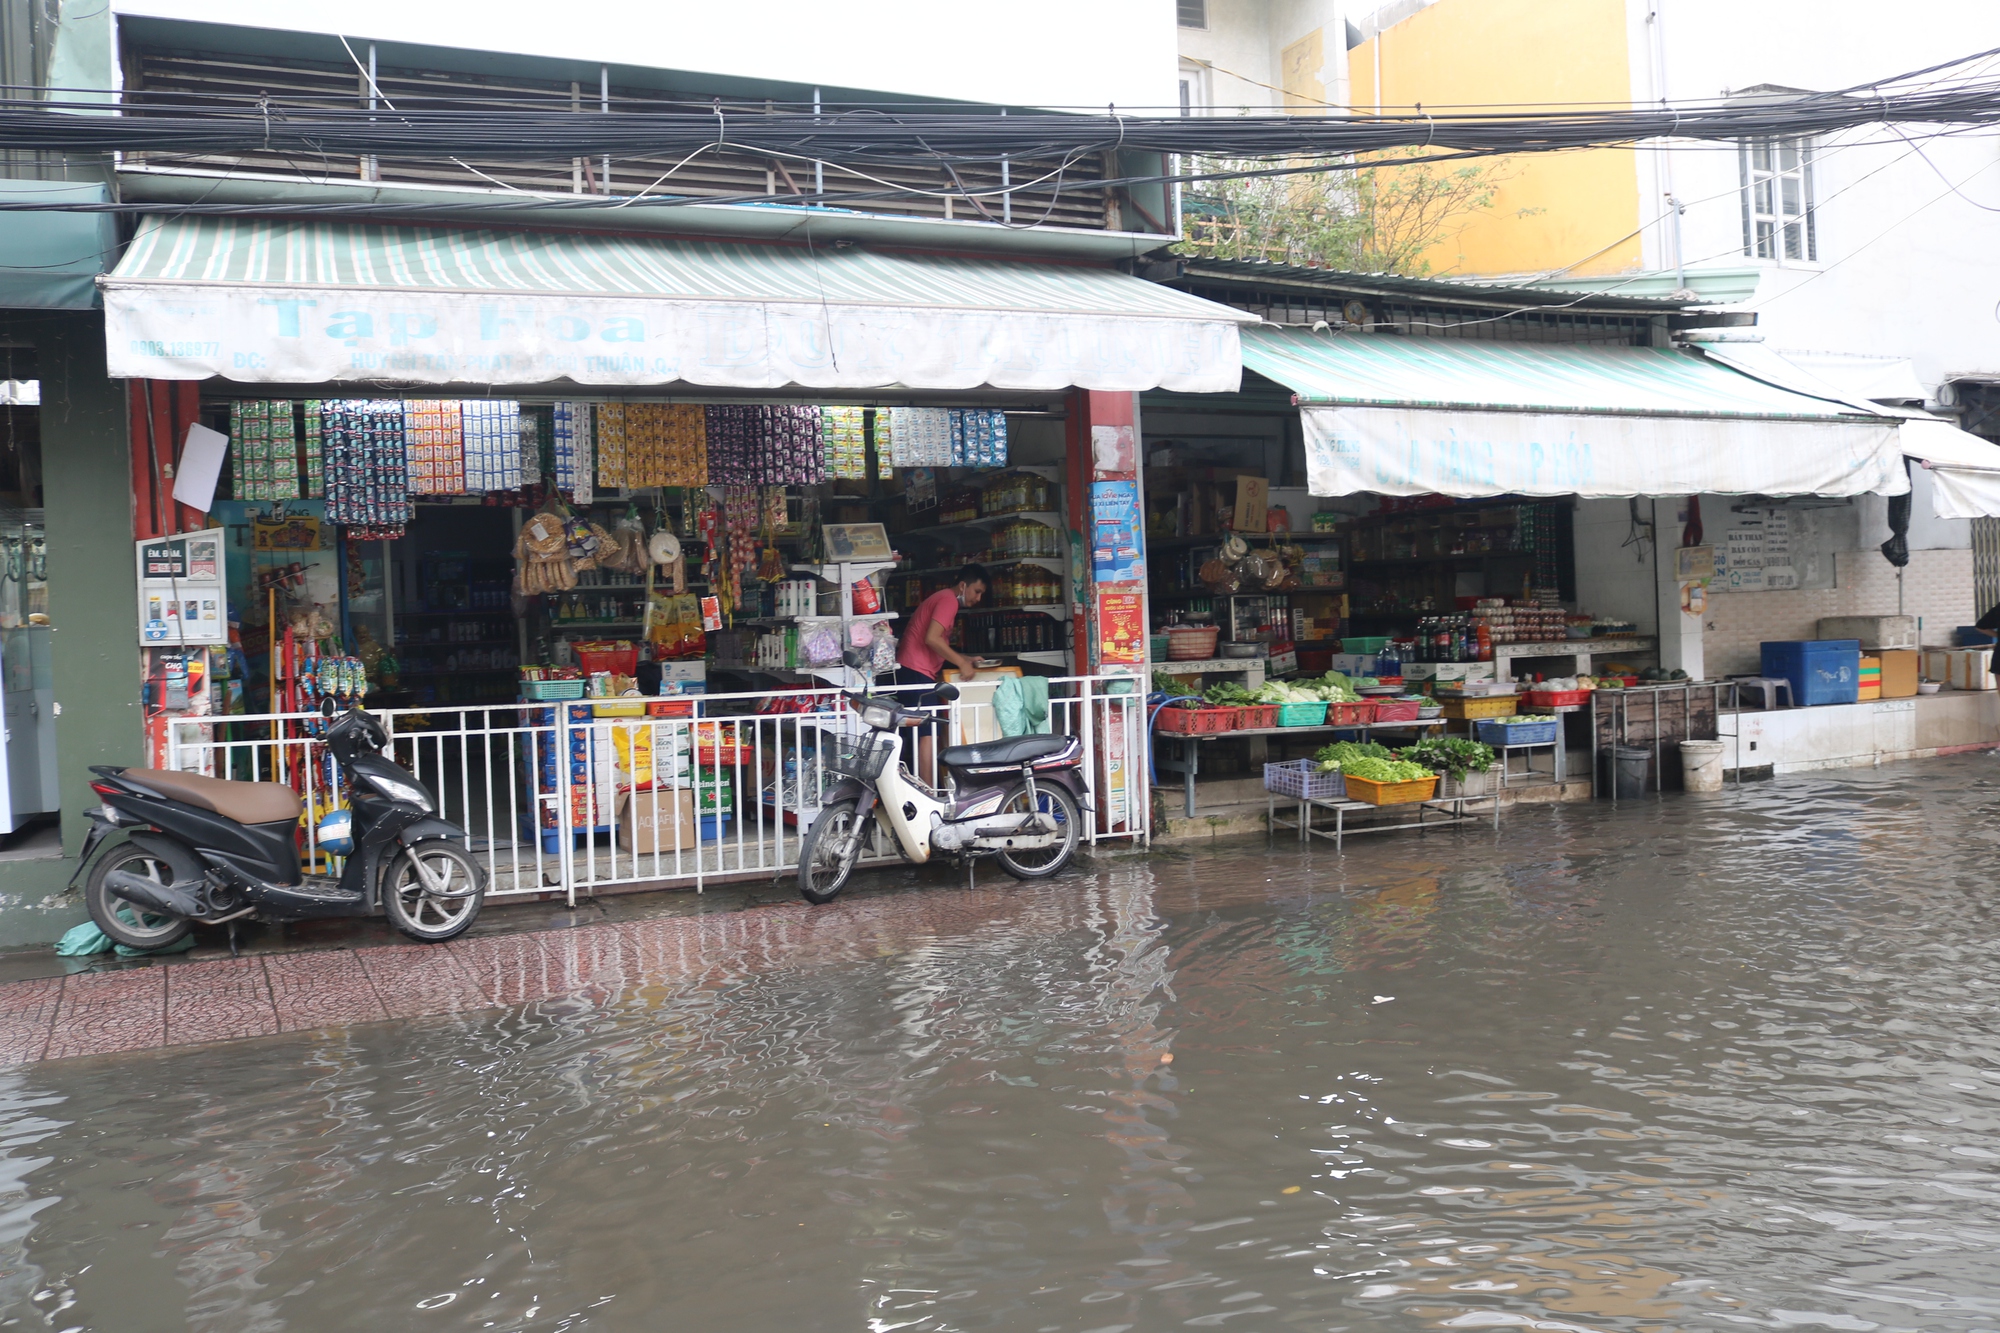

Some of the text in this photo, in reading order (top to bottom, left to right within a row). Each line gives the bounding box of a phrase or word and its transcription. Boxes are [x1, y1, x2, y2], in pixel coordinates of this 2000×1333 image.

[257, 297, 646, 347] Tạp Hóa
[130, 340, 220, 356] 0903.136977
[233, 352, 266, 369] ĐC:
